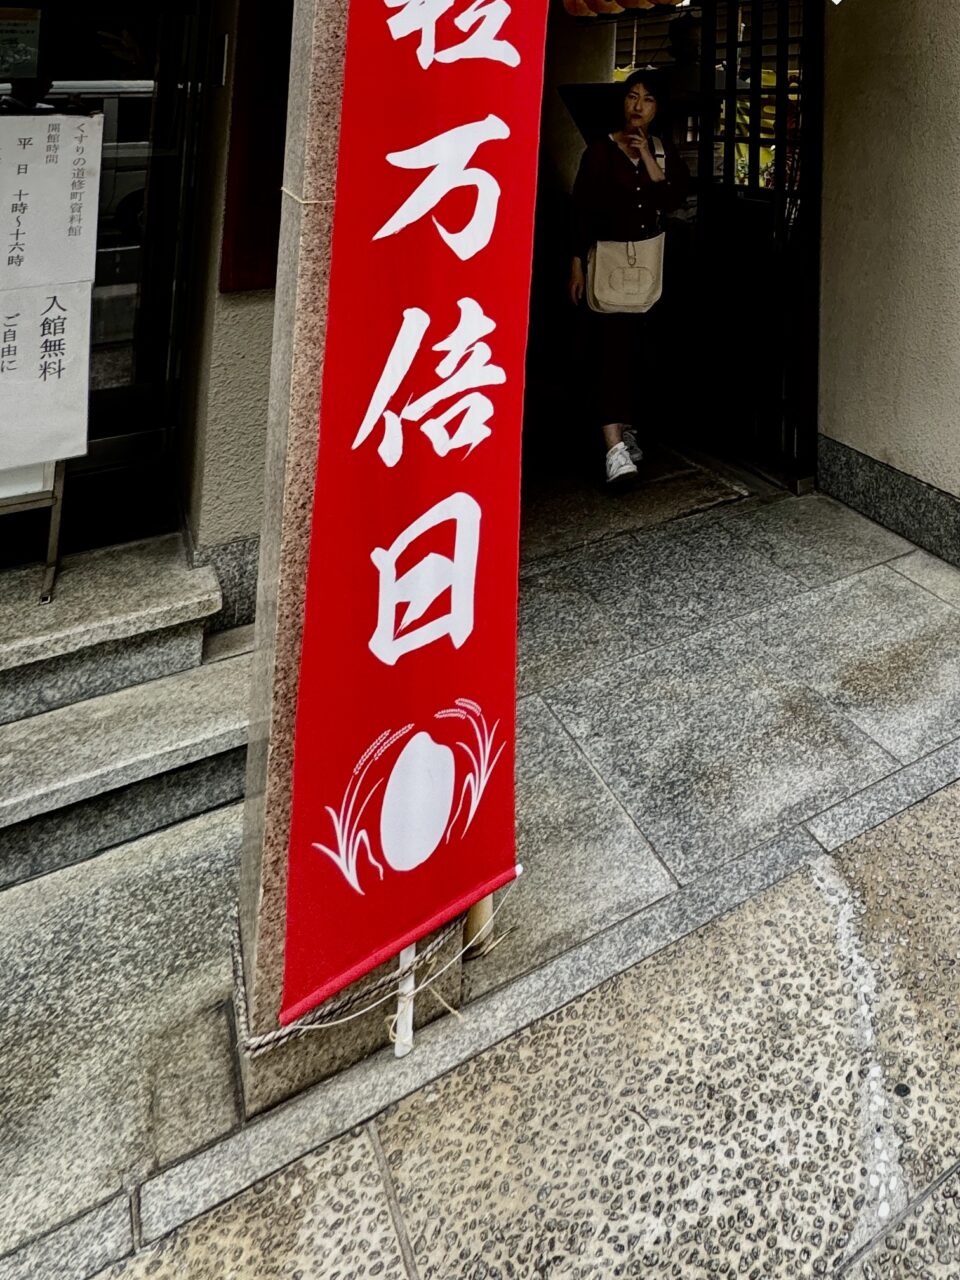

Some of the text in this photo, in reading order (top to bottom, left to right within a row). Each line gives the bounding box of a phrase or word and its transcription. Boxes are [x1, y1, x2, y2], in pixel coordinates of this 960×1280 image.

[44, 122, 60, 165] 開館時間
[67, 122, 88, 238] くすりの道修町資料館
[0, 313, 20, 374] ご自由に
[39, 294, 68, 381] 入館無料
